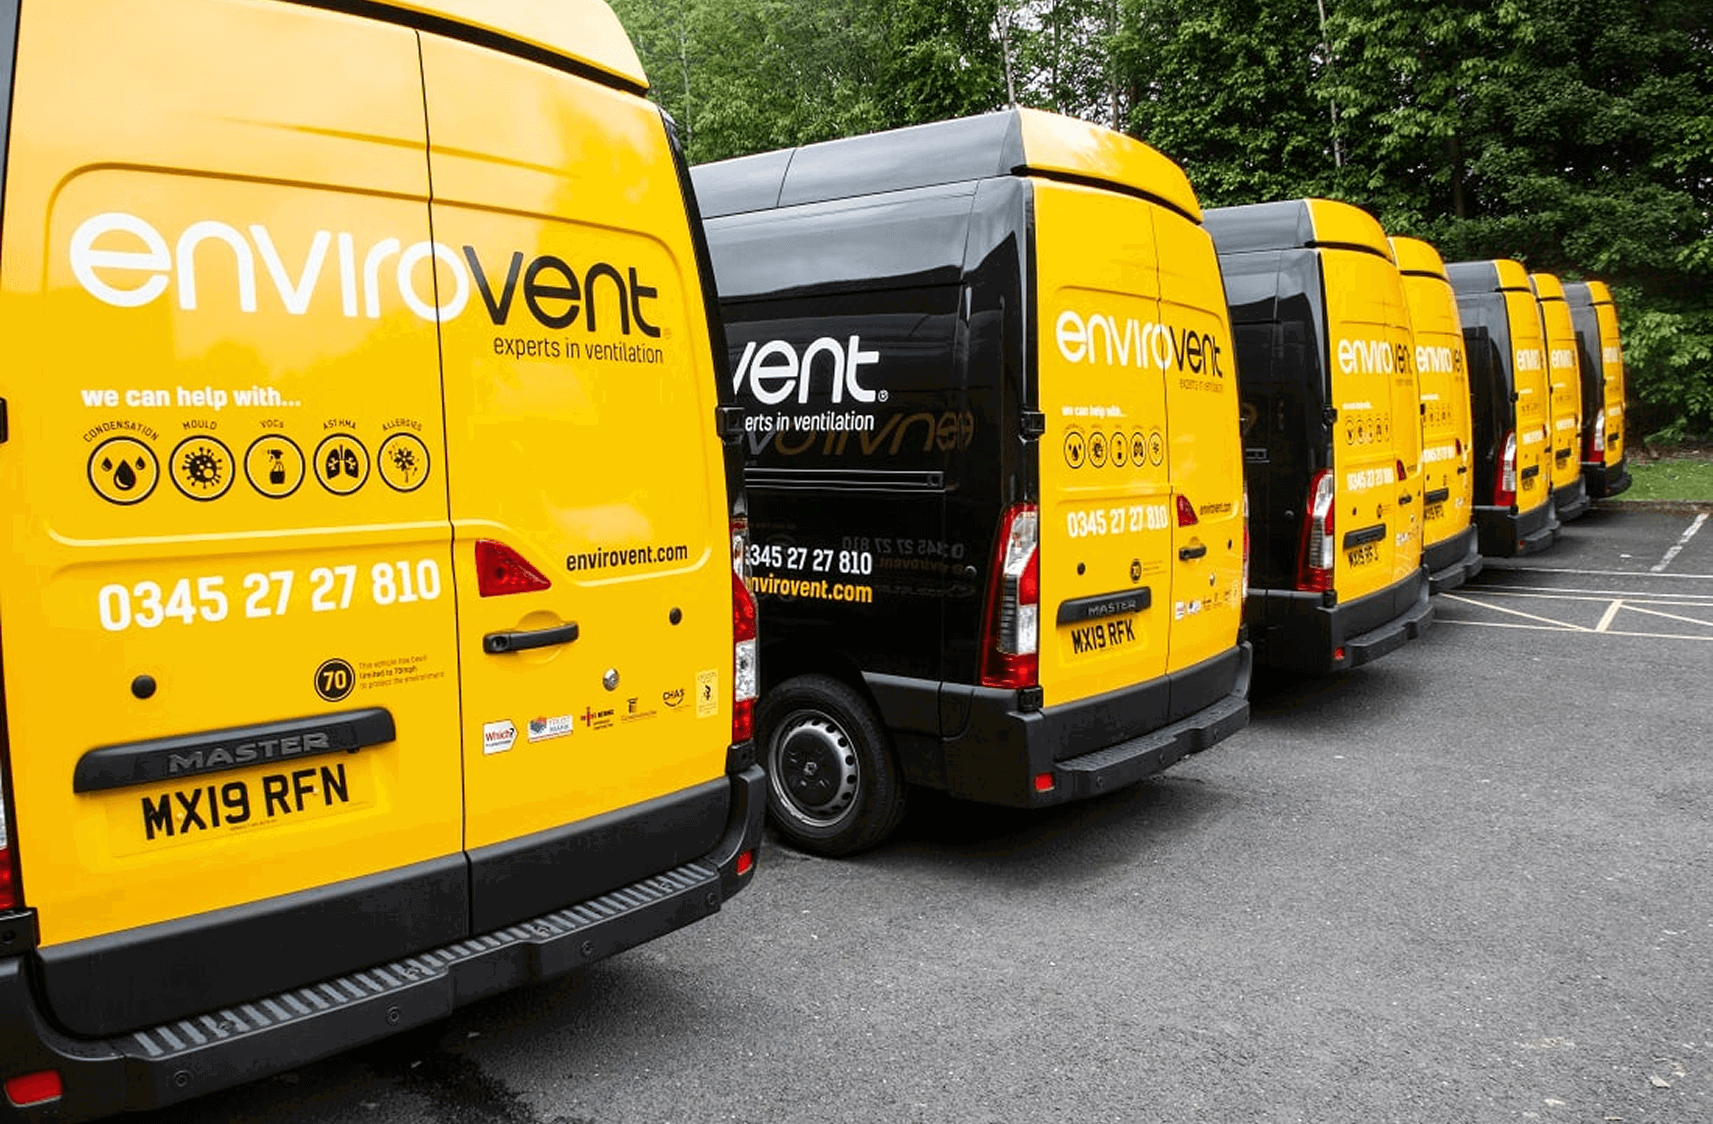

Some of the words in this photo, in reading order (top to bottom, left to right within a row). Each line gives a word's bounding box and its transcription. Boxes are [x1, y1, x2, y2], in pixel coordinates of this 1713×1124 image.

[69, 212, 661, 338] envirovent
[494, 336, 560, 359] experts
[566, 337, 580, 359] in
[585, 341, 664, 364] ventilation
[1056, 310, 1223, 378] envirovent
[79, 389, 119, 407] we
[125, 389, 170, 407] can
[176, 386, 228, 411] help
[233, 385, 301, 407] with...
[83, 420, 160, 443] CONDENSATION
[182, 420, 218, 431] MOULD
[322, 418, 358, 431] ASTHMA
[776, 411, 790, 431] in
[794, 411, 874, 432] ventilation
[1067, 508, 1106, 538] 0345
[1110, 507, 1125, 534] 27
[1129, 505, 1144, 532] 27
[1146, 505, 1168, 530] 810
[566, 545, 688, 571] envirovent.com
[746, 545, 782, 567] 345
[787, 547, 807, 570] 27
[812, 549, 834, 572] 27
[839, 551, 872, 575] 810
[98, 576, 229, 632] 0345
[243, 570, 294, 618] 27
[309, 565, 357, 612] 27
[371, 559, 441, 606] 810
[749, 573, 872, 603] nvirovent.com
[1088, 600, 1137, 616] MASTER
[1071, 625, 1106, 654] MX19
[1108, 618, 1135, 646] RFK
[323, 670, 347, 691] 70
[486, 728, 514, 741] Which?
[169, 731, 330, 773] MASTER
[142, 781, 251, 841] MX19
[262, 764, 349, 816] RFN
